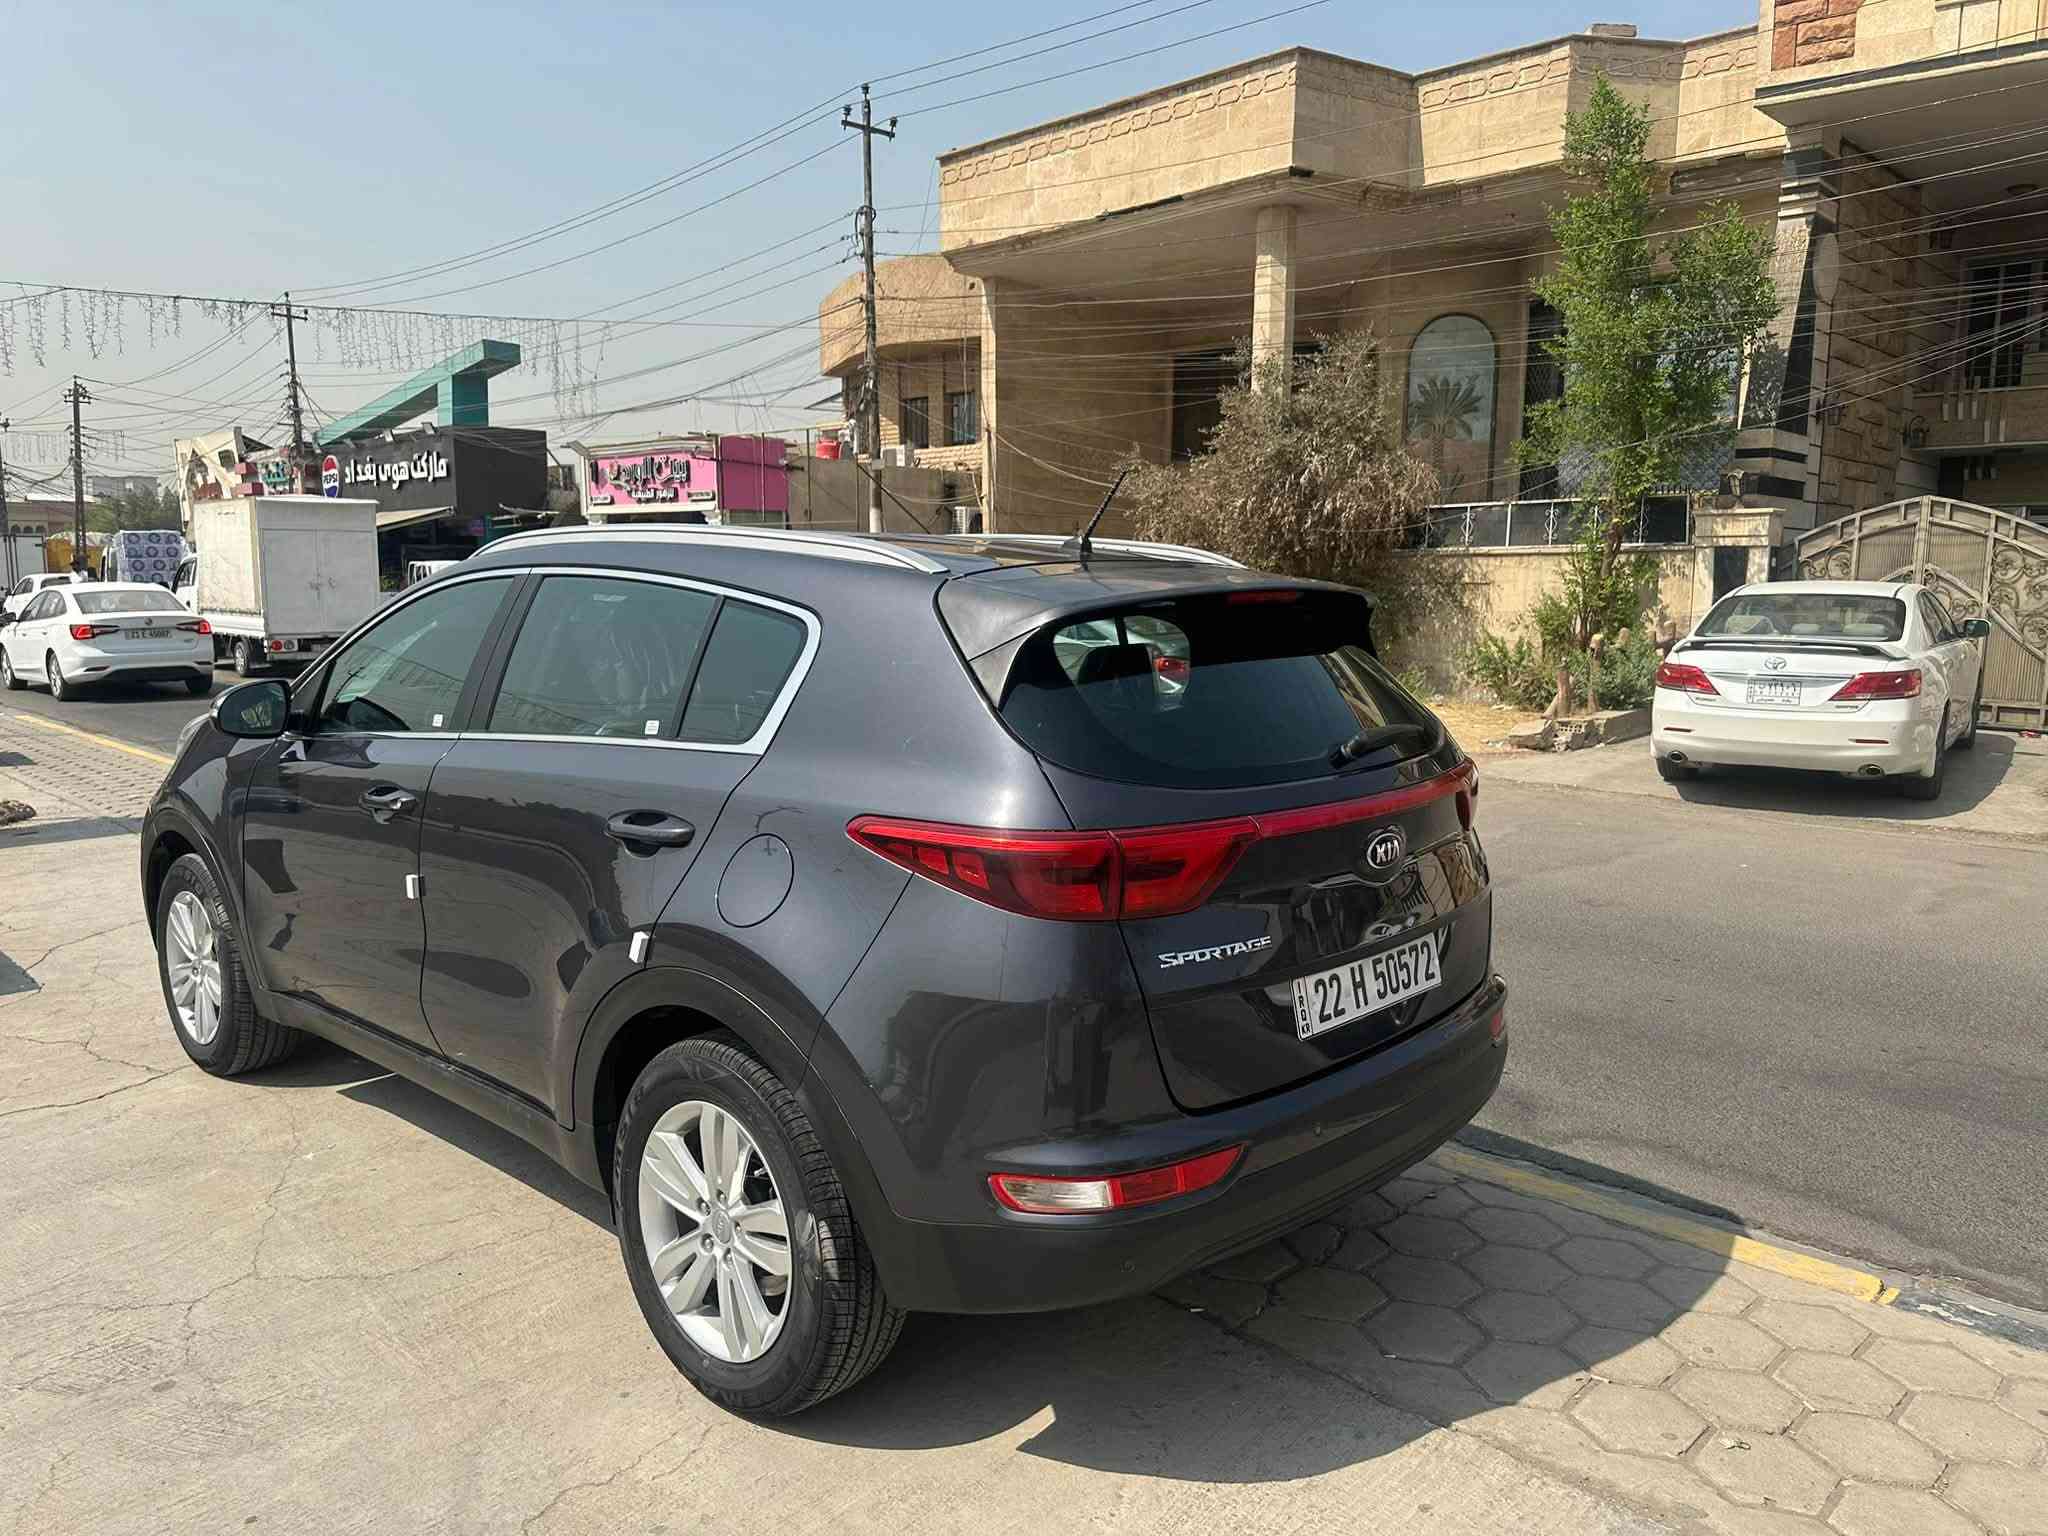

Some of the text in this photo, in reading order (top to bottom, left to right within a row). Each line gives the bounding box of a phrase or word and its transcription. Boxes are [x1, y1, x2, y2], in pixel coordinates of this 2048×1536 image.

[345, 455, 378, 487] بغداد
[410, 451, 448, 482] ماركت
[1376, 840, 1400, 863] KIA
[1158, 936, 1272, 969] SPORTAGE
[1314, 940, 1436, 1024] 22 H 50572
